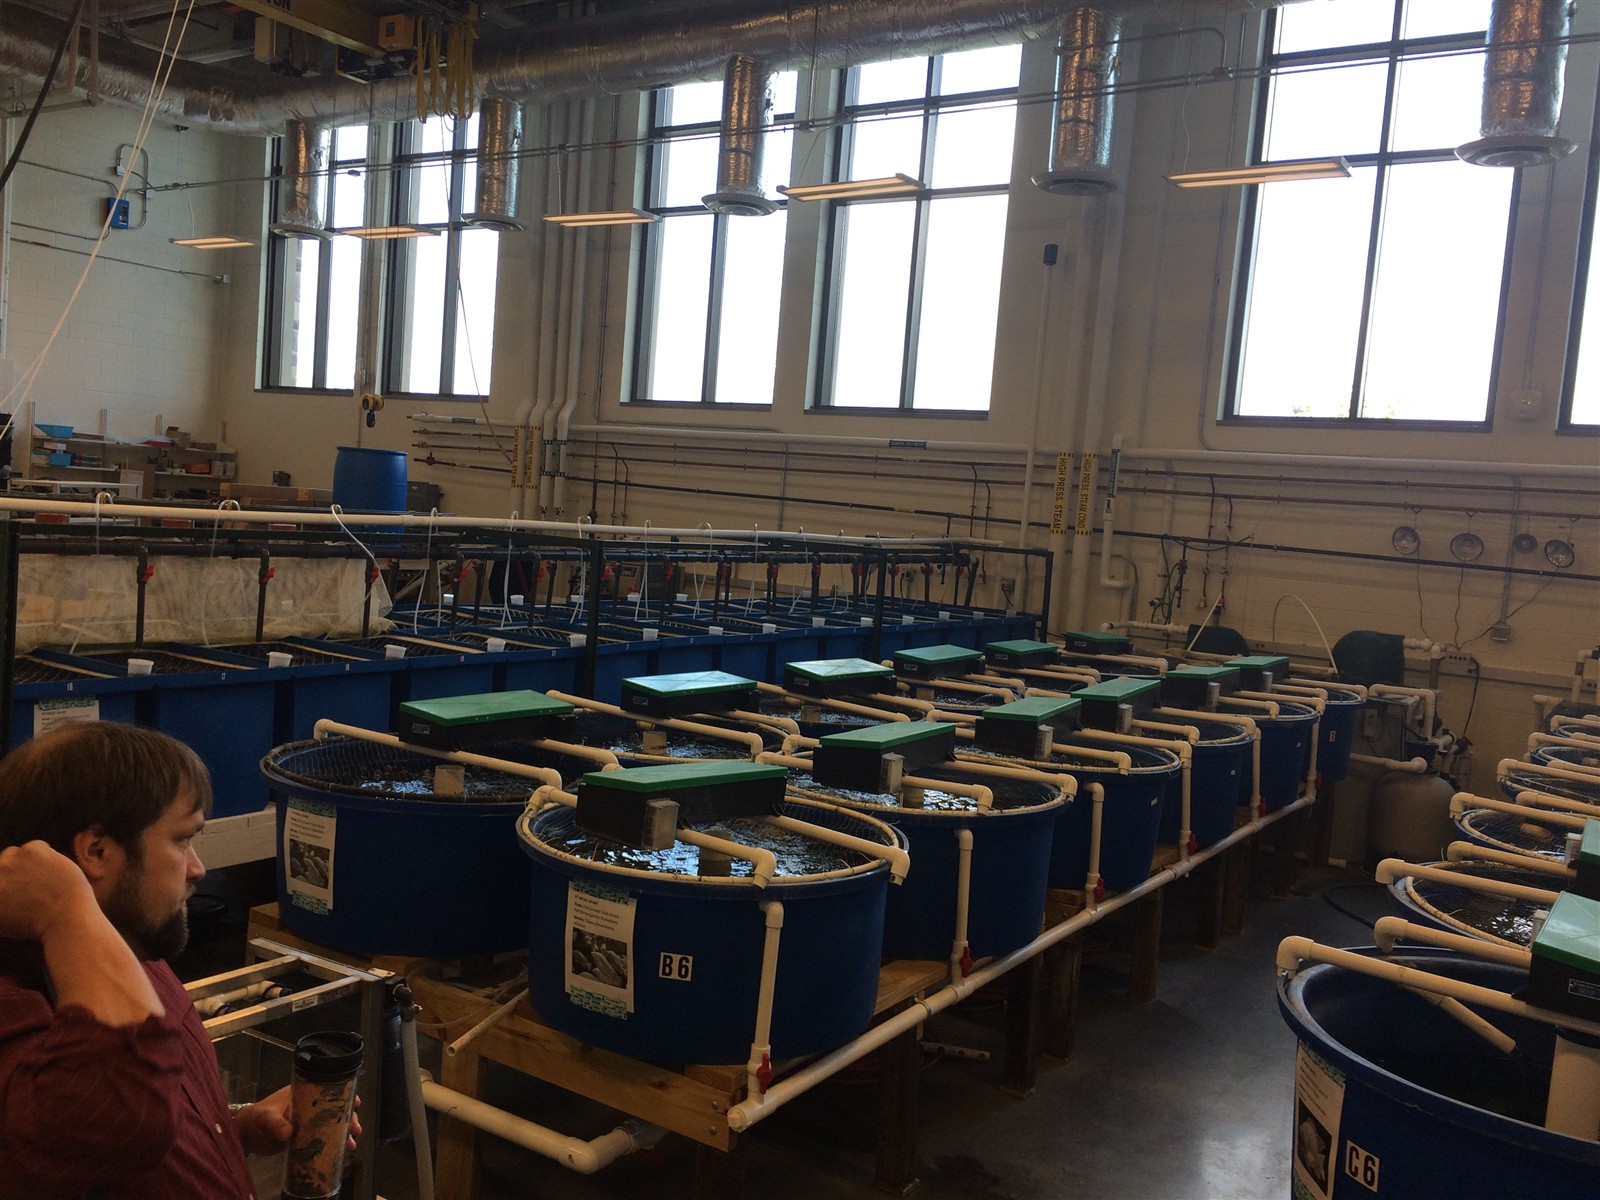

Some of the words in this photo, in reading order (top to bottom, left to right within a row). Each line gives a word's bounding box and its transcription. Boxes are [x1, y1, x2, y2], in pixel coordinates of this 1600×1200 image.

[1058, 457, 1067, 476] HIGH
[1082, 458, 1092, 472] HIGH
[1055, 477, 1066, 503] PRESS.
[1079, 493, 1089, 512] STEAM
[1053, 504, 1062, 529] STEAM
[662, 954, 690, 979] B6
[1348, 1146, 1376, 1187] C6
